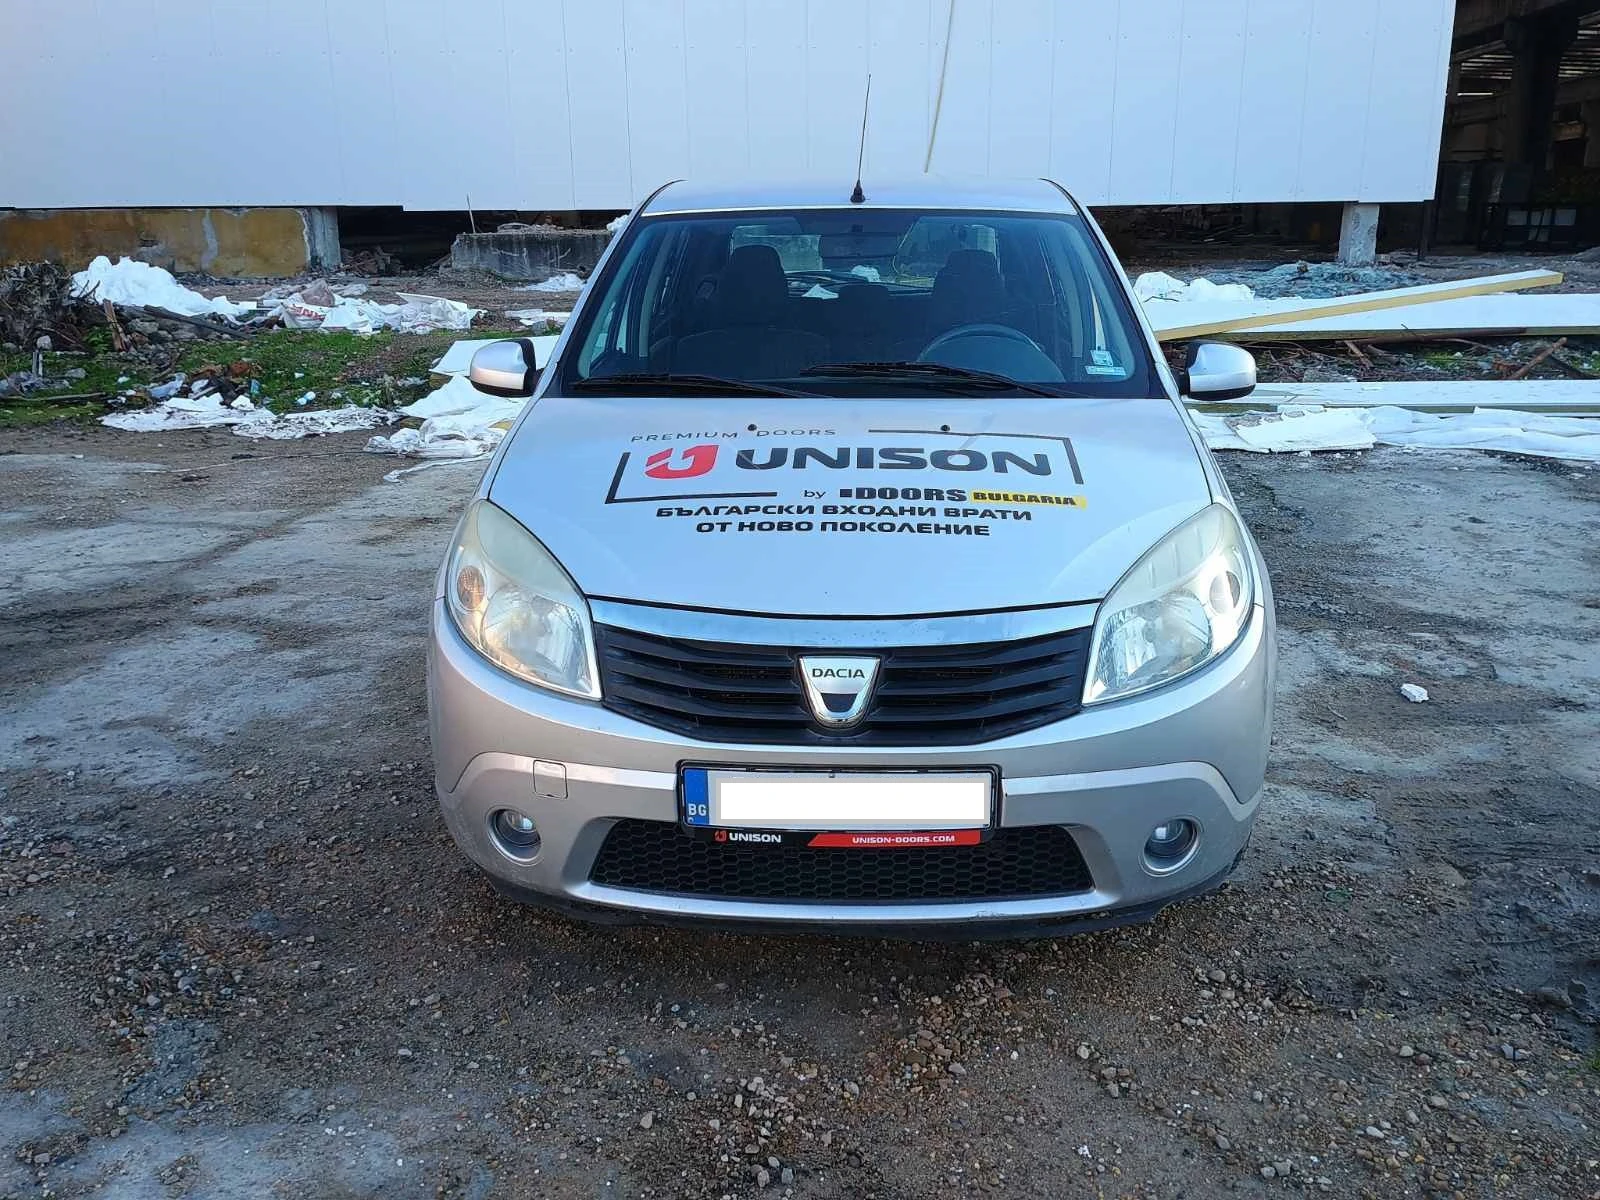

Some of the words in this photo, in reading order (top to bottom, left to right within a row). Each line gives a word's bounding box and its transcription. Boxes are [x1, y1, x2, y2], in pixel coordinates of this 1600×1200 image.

[631, 431, 738, 443] PREMIUM
[756, 429, 836, 437] DOORS
[736, 447, 1052, 476] UNISON
[804, 488, 827, 499] by
[856, 487, 967, 502] DOORS
[973, 491, 1077, 506] BULGARIA
[656, 505, 815, 517] БЪЛГАРСКИ
[822, 505, 937, 518] ВХОДНИ
[944, 507, 1032, 521] ВРАТИ
[696, 522, 732, 533] ОТ
[738, 521, 814, 532] НОВО
[820, 521, 990, 537] ПОКОЛЕНИЕ
[812, 668, 865, 678] DACIA
[688, 803, 707, 817] BG
[729, 832, 782, 843] UNISON
[852, 835, 955, 844] UNISON-DOORS.COM
